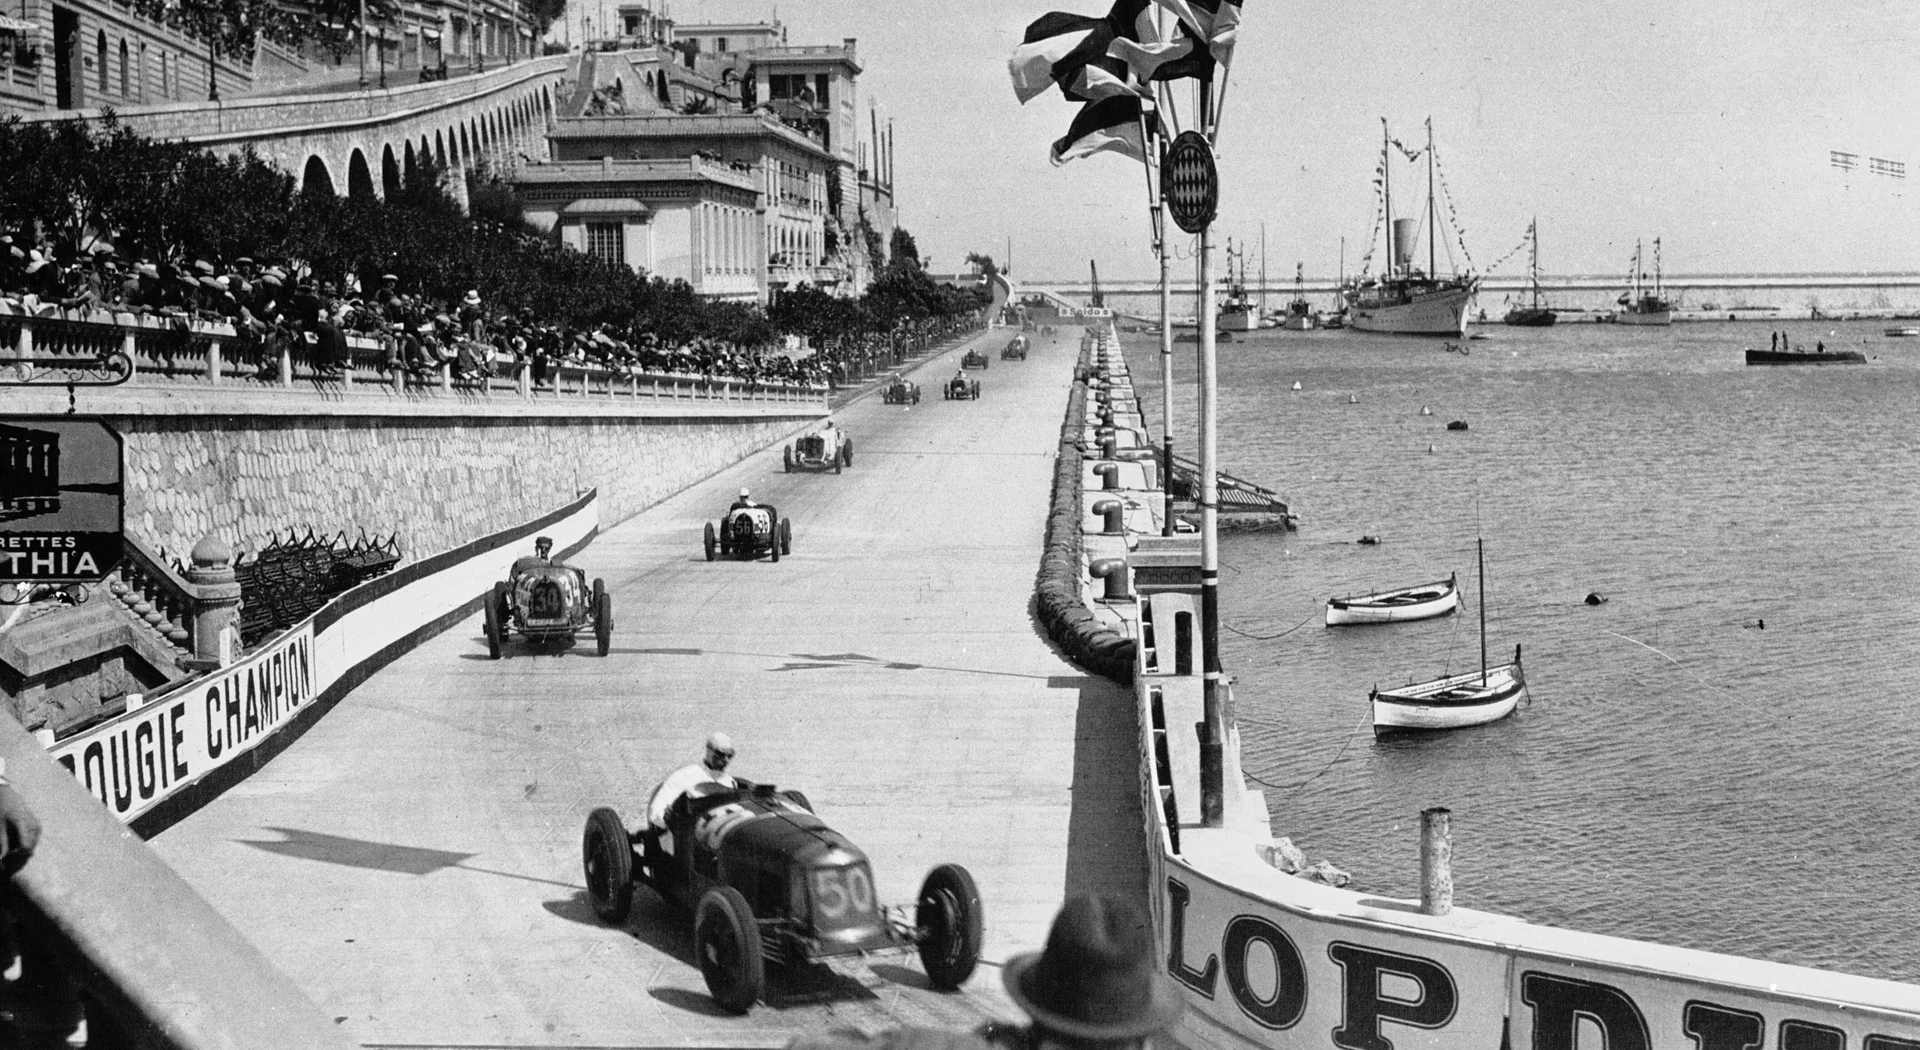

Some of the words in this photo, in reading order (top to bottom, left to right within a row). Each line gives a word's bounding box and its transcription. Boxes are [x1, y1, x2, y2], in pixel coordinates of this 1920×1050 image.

[735, 520, 751, 535] 56
[6, 551, 100, 575] THIA
[205, 634, 311, 760] CHAMPION
[816, 866, 872, 918] 50
[1167, 876, 1459, 1050] LOP
